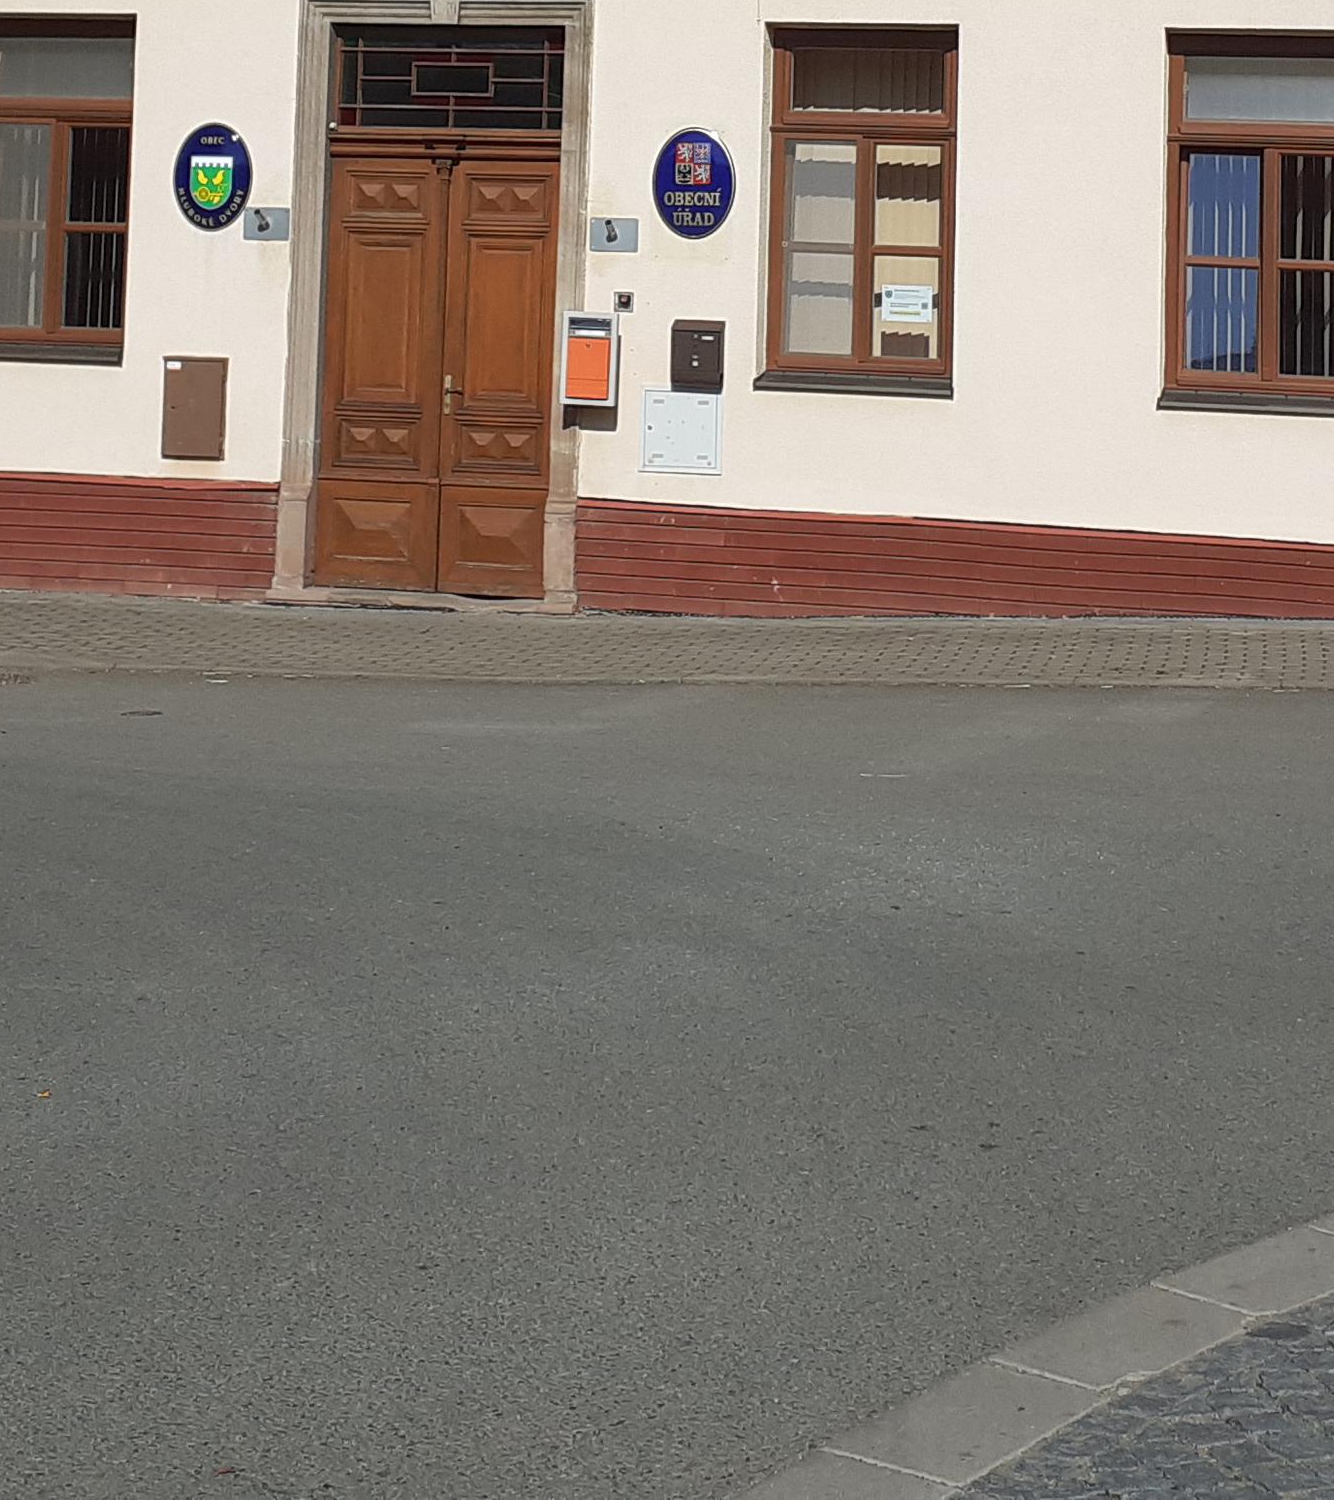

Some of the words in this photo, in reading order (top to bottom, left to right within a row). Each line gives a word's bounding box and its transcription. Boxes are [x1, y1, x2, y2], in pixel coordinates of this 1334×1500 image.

[200, 136, 225, 145] OBEC
[219, 189, 244, 223] DVORY
[663, 188, 722, 206] OBECNÍ
[672, 208, 715, 226] ÚŘAD
